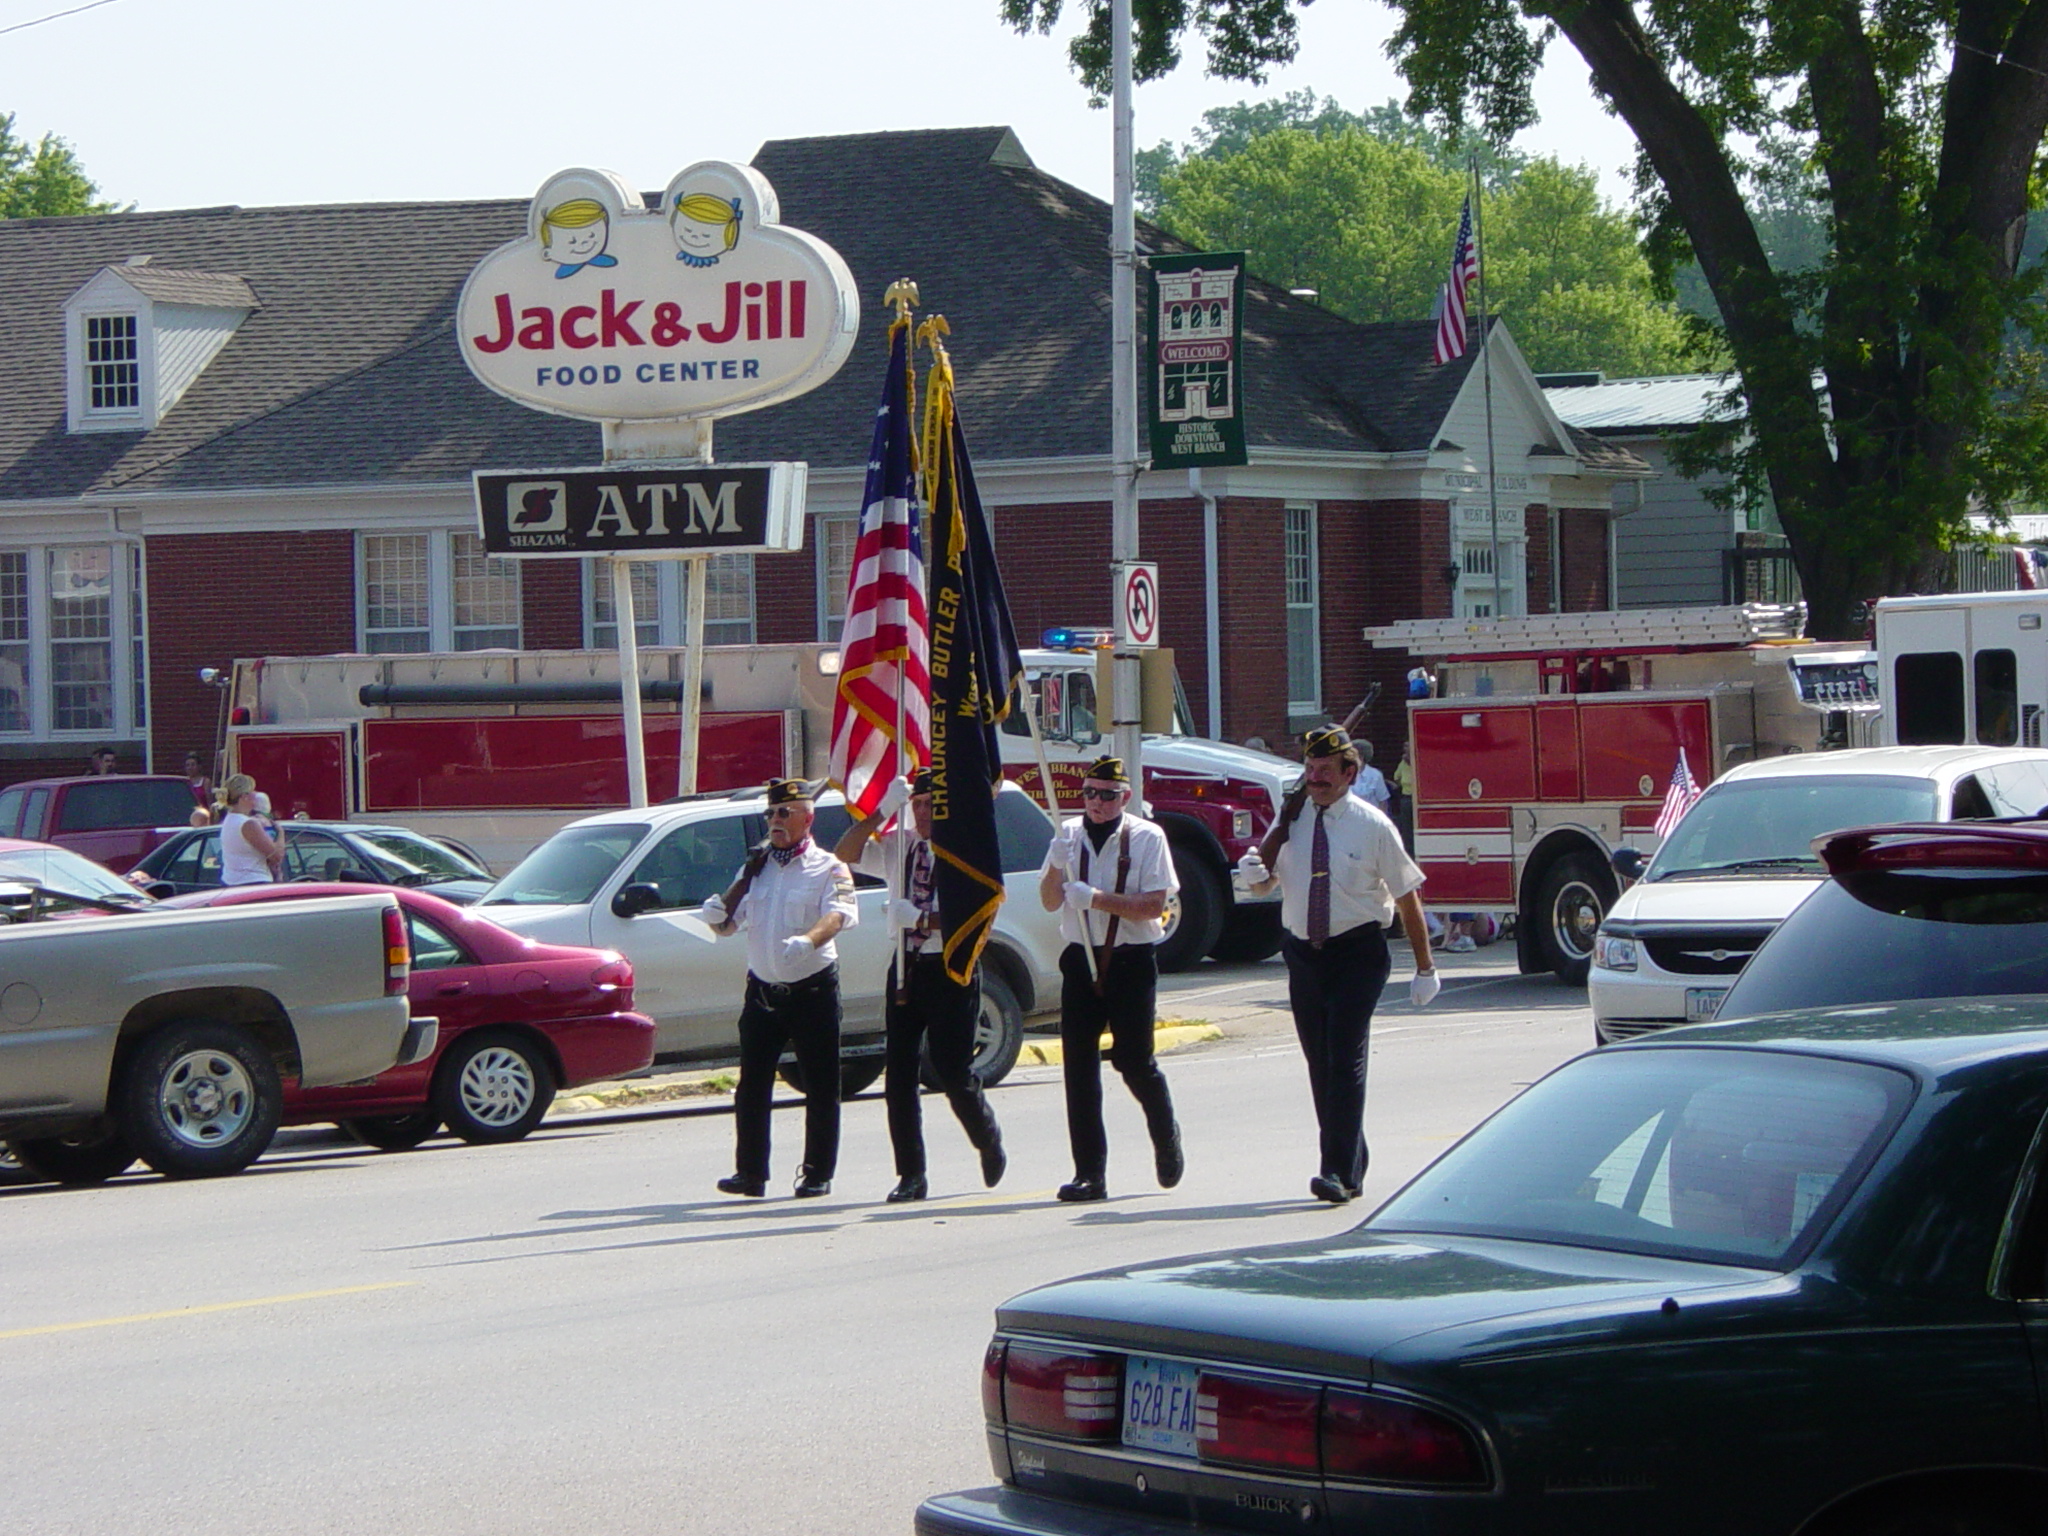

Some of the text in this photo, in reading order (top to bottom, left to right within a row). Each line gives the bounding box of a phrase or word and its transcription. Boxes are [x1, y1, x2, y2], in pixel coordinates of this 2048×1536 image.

[1167, 345, 1223, 360] WELCOME
[537, 359, 760, 387] FOOD CENTER
[1179, 422, 1216, 433] HISTORIC
[1175, 432, 1220, 443] DOWNTOWN
[1171, 442, 1225, 454] WEST BRANCH
[1491, 475, 1527, 490] UILDING
[586, 481, 743, 539] ATM
[1485, 509, 1517, 522] BANCH
[509, 533, 568, 547] SHAZAM
[933, 586, 961, 679] BUTLER
[931, 692, 949, 821] CHAUNCEY
[1051, 763, 1086, 779] BRAN
[1130, 1380, 1164, 1426] 628
[1235, 1493, 1291, 1513] BUICK
